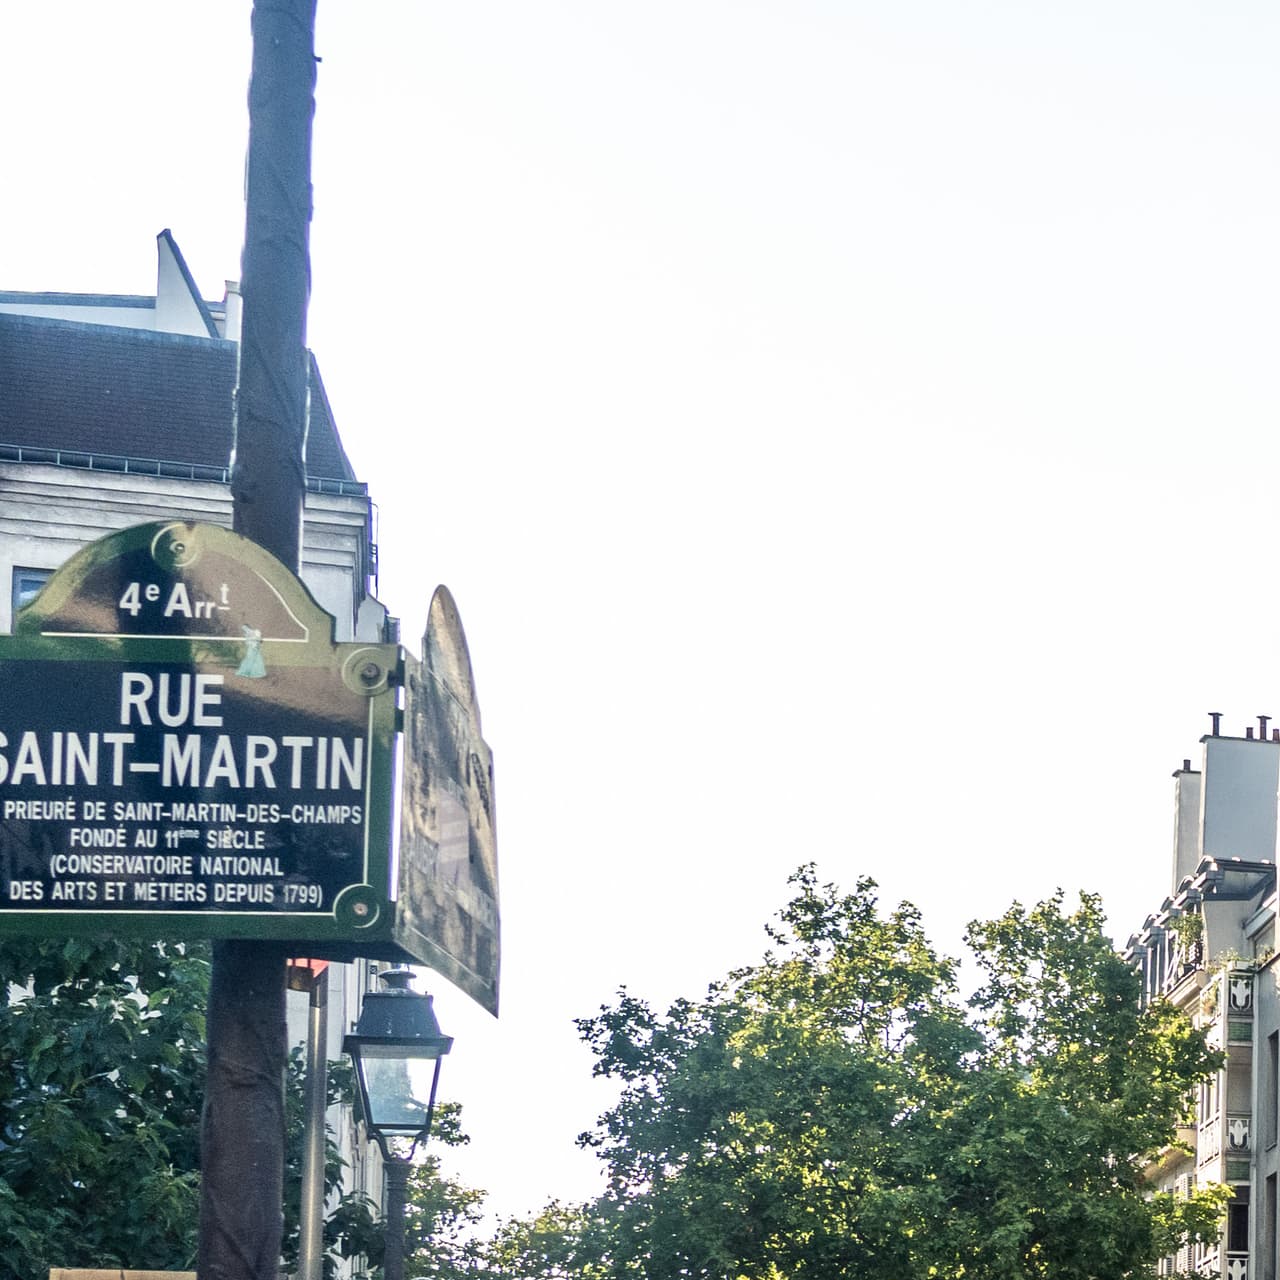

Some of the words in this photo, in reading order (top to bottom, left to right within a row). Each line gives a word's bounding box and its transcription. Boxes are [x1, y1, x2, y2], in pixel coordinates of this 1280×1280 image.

[119, 582, 160, 616] 4e
[120, 672, 225, 727] RUE
[4, 797, 76, 821] PRIEURÉ
[83, 802, 106, 821] DE
[113, 802, 362, 825] SAINT-MARTIN-DES-CHAMPS
[71, 823, 126, 847] FONDÉ
[134, 829, 157, 848] AU
[207, 825, 265, 850] SIÈCLE
[50, 855, 192, 878] (CONSERVATOIRE
[200, 857, 284, 876] NATIONAL
[10, 881, 43, 900] DES
[52, 882, 97, 901] ARTS
[104, 883, 126, 901] ET
[134, 876, 206, 902] MÉTIERS
[214, 884, 274, 903] DEPUIS
[283, 884, 323, 908] 1799)
